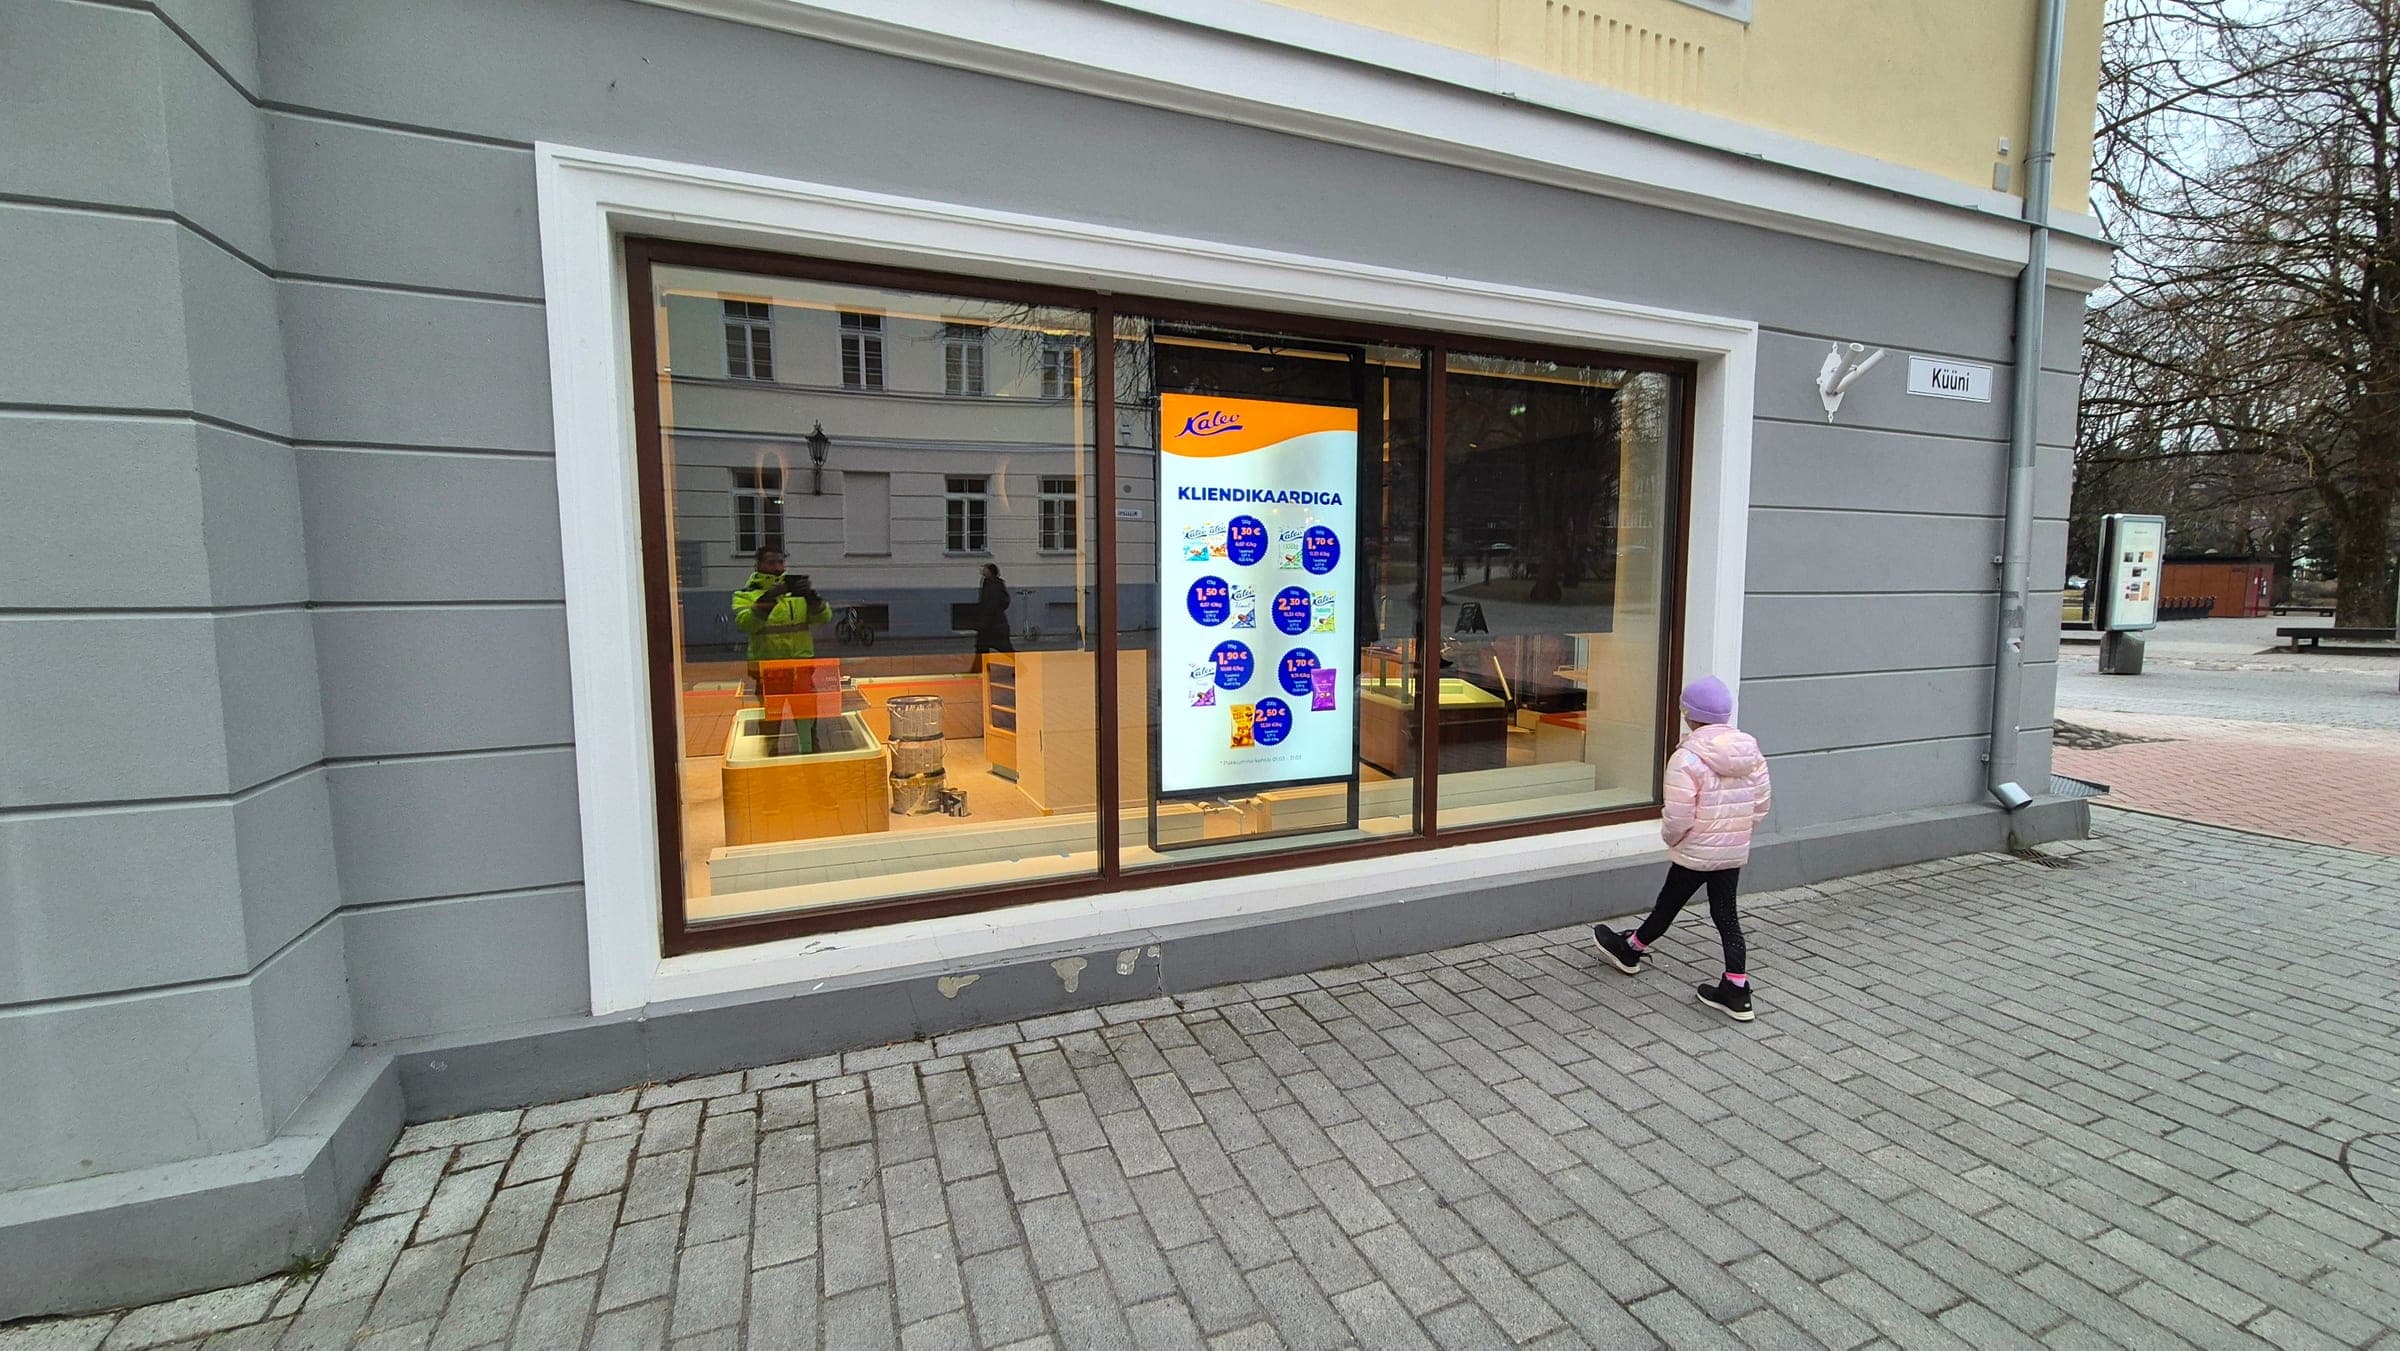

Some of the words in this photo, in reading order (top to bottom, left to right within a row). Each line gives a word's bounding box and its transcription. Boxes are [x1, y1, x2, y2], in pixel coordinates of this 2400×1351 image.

[1932, 368, 1969, 392] Küüni
[1178, 486, 1343, 506] KLIENDIKAARDIGA
[1231, 526, 1252, 540] 1.30
[1306, 536, 1326, 550] 1.70
[1196, 587, 1217, 601] 1.50
[1278, 597, 1300, 611] 2.30
[1286, 658, 1307, 672] 1.70
[1255, 708, 1277, 722] 2.50
